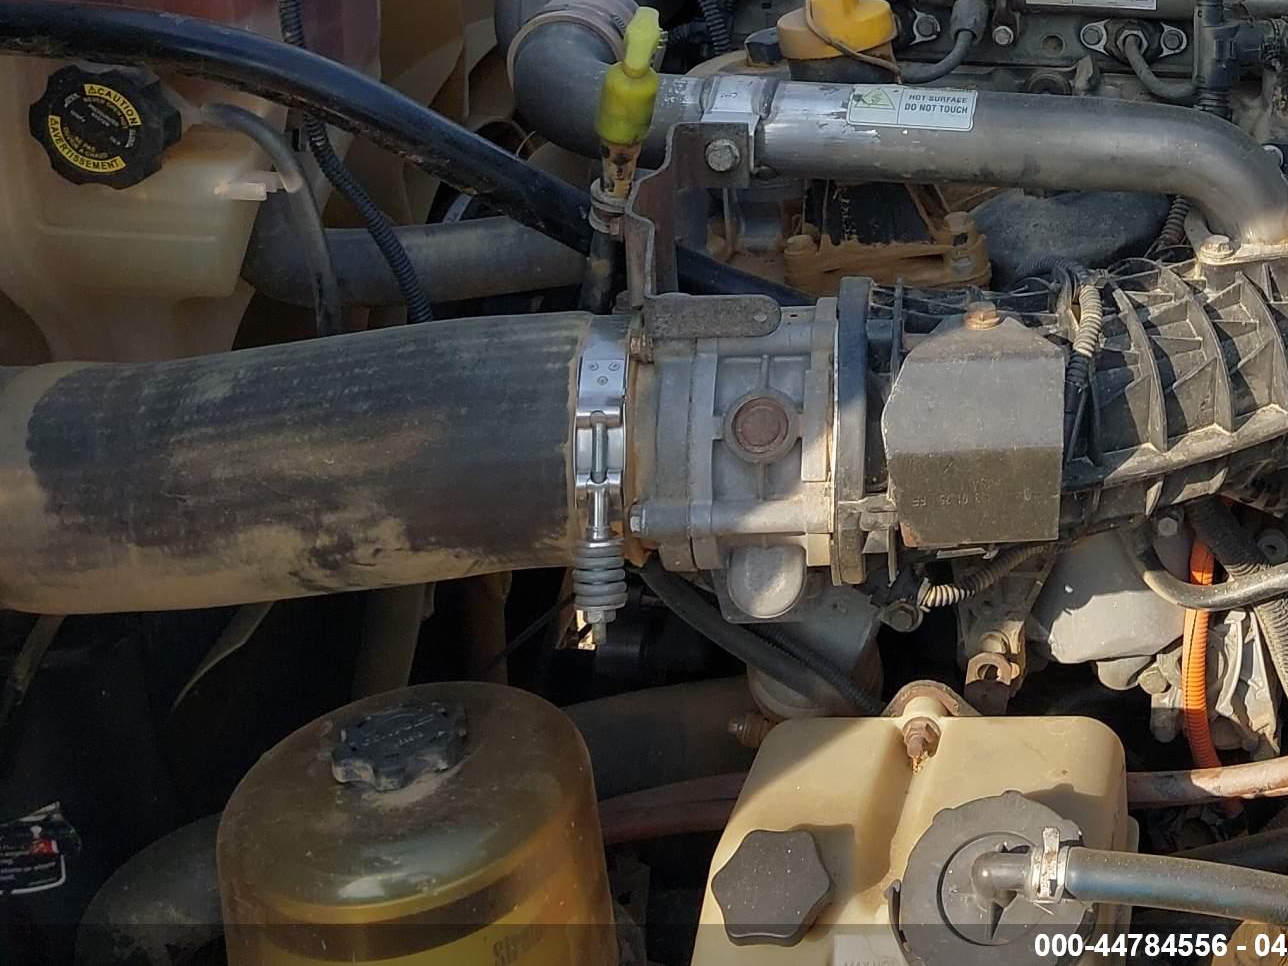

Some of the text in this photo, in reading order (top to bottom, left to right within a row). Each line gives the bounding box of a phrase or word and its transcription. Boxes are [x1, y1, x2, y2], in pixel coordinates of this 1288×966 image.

[97, 86, 140, 126] CAUTION
[905, 103, 968, 114] DO NOT TOUCH
[908, 94, 968, 104] HOT SURFACE
[50, 127, 121, 170] AVERTISSEMENT
